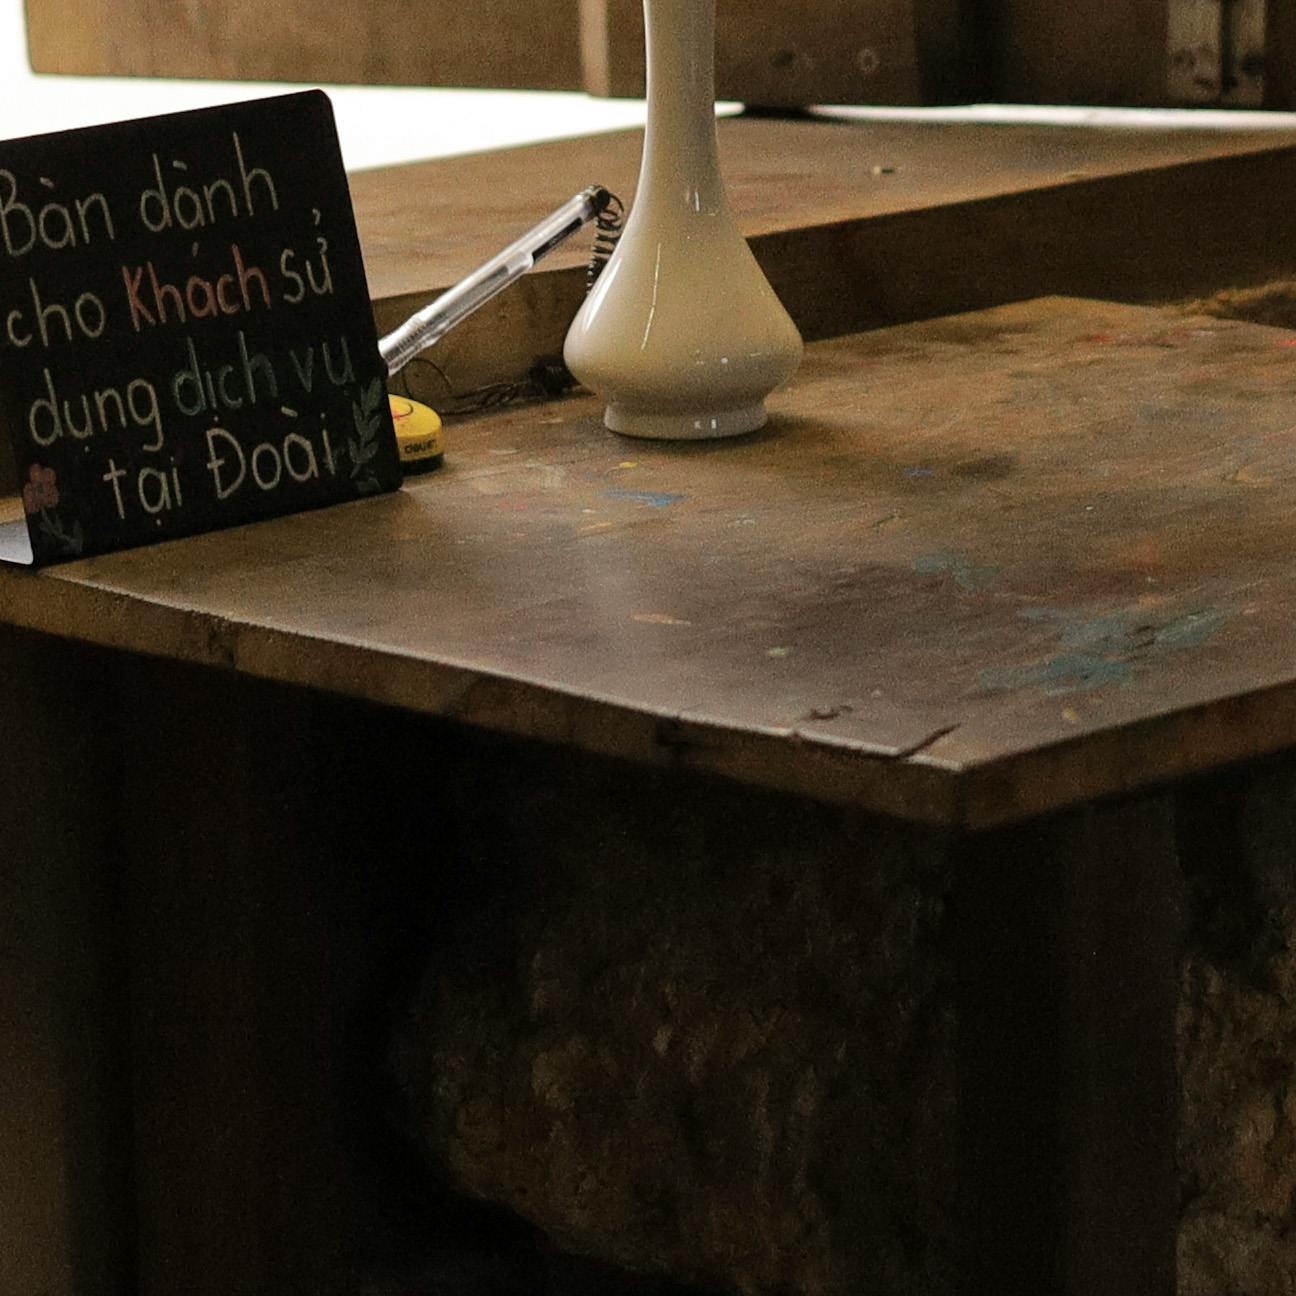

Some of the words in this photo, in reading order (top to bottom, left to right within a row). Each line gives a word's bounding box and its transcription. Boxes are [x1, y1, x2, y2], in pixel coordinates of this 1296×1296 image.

[140, 131, 279, 232] dành
[7, 277, 105, 348] cho
[122, 242, 271, 332] Khách
[29, 367, 164, 452] dụng
[103, 457, 183, 526] tại
[206, 406, 336, 500] Đoài
